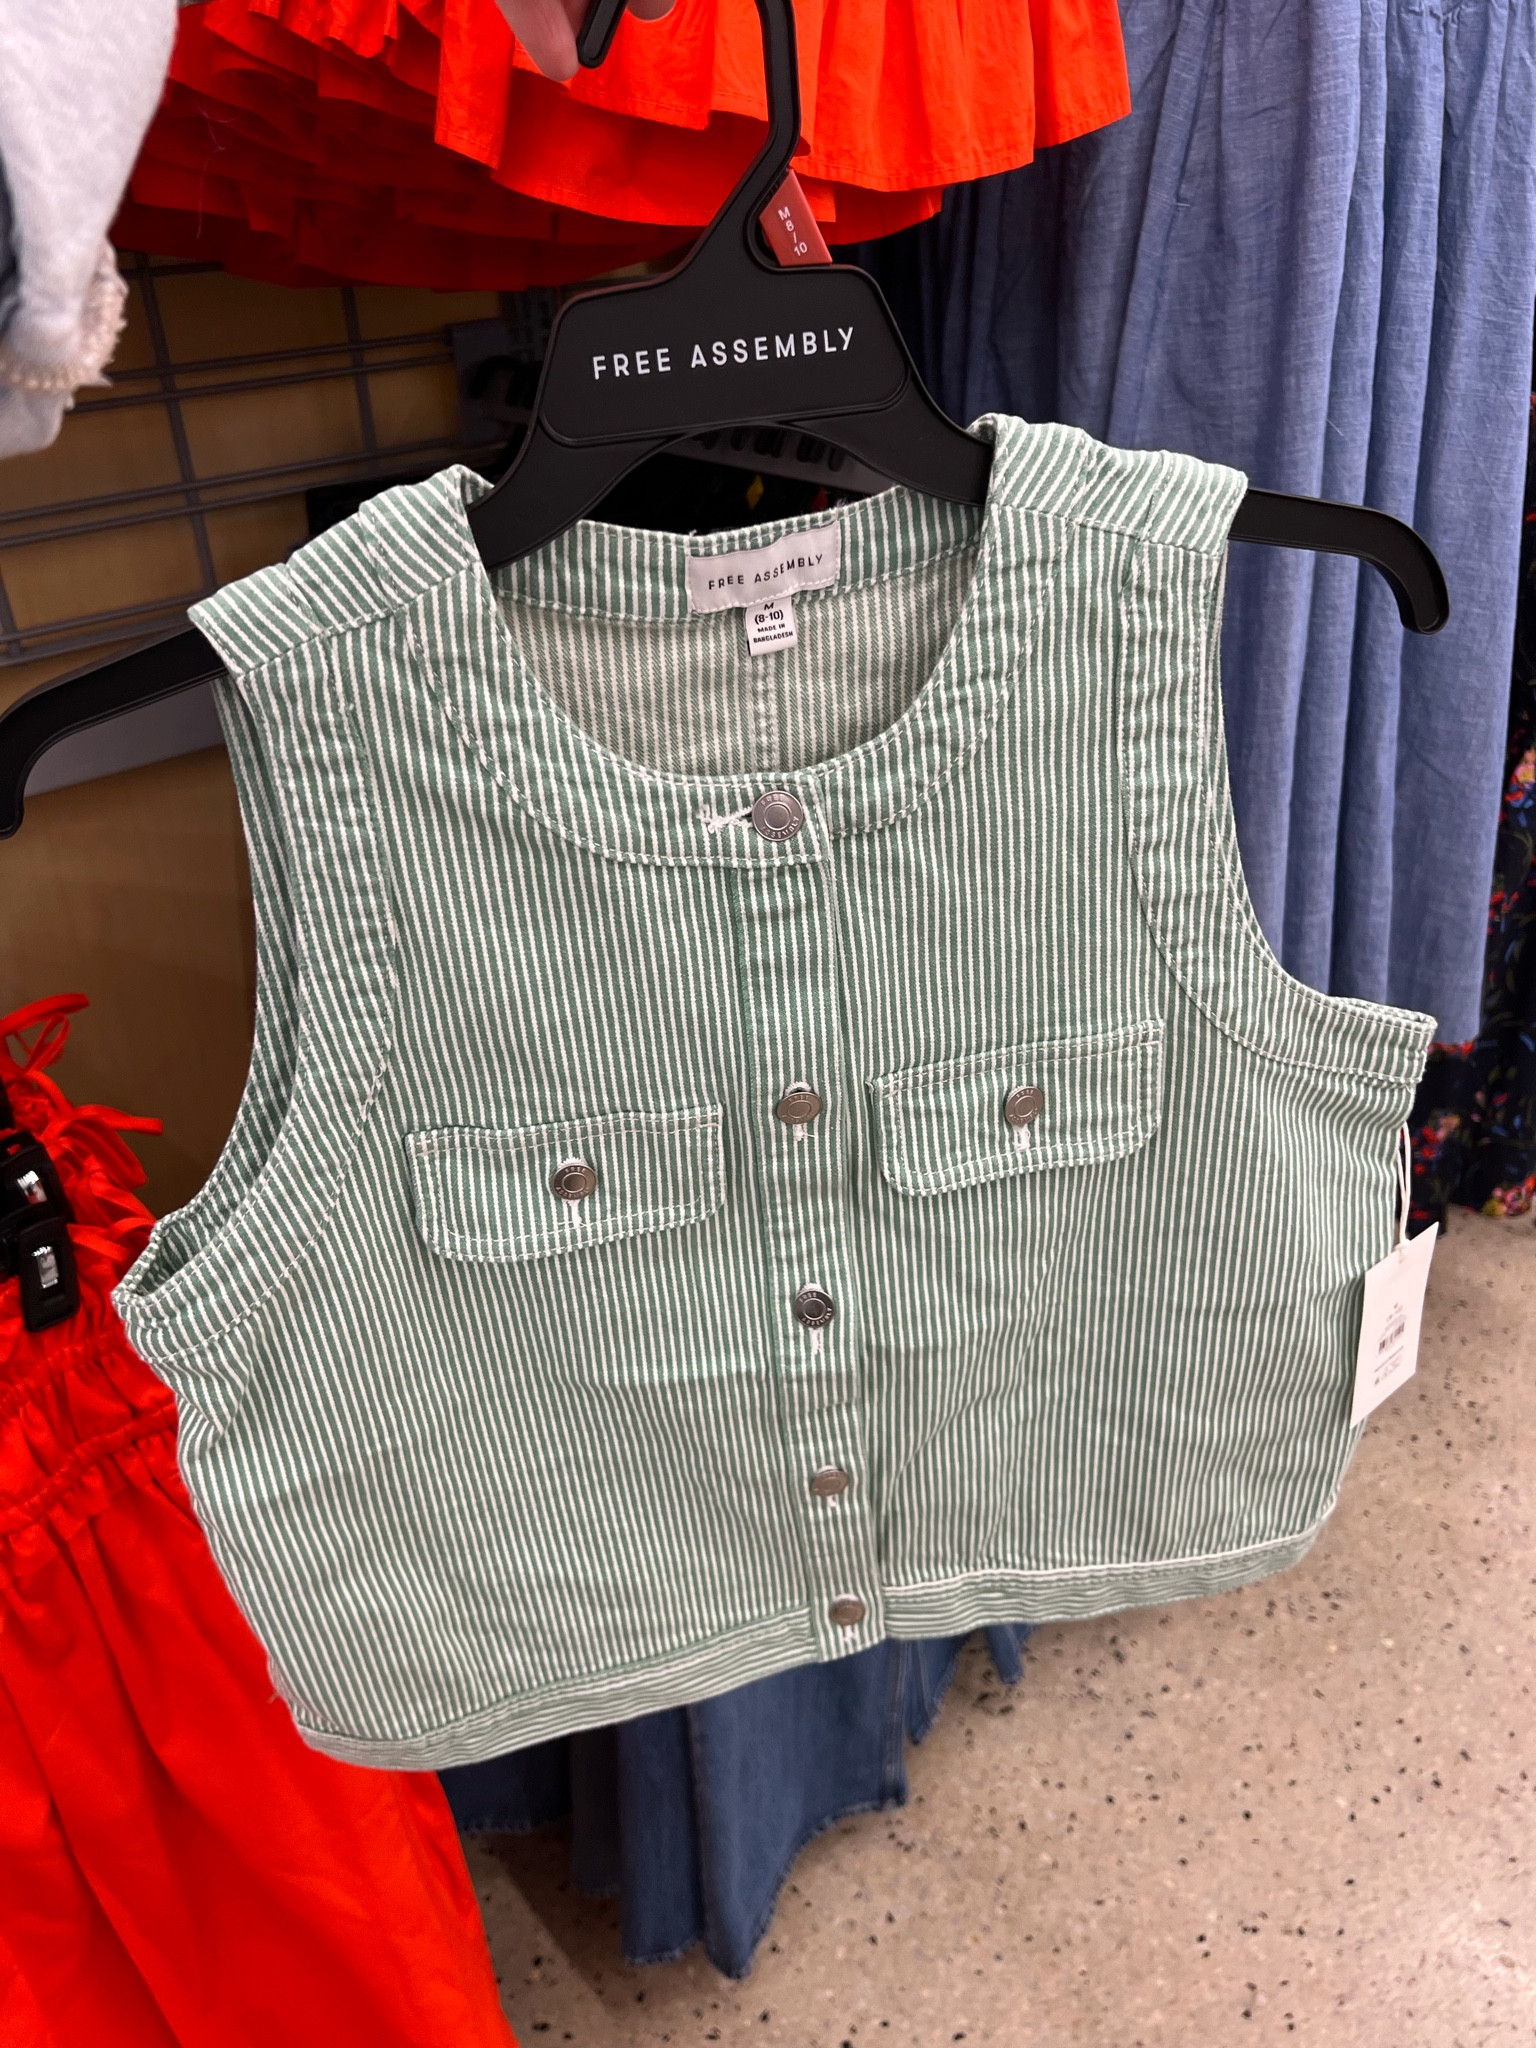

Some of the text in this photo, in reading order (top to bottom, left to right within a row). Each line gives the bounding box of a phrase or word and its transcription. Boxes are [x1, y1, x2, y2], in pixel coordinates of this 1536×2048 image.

[778, 206, 791, 221] M
[592, 326, 854, 380] FREE ASSEMBLY
[708, 554, 823, 590] FREE ASSEMBLY
[763, 602, 775, 611] M
[754, 609, 784, 625] (8-10)
[757, 625, 776, 633] MADE
[753, 631, 794, 643] BANGLADESH
